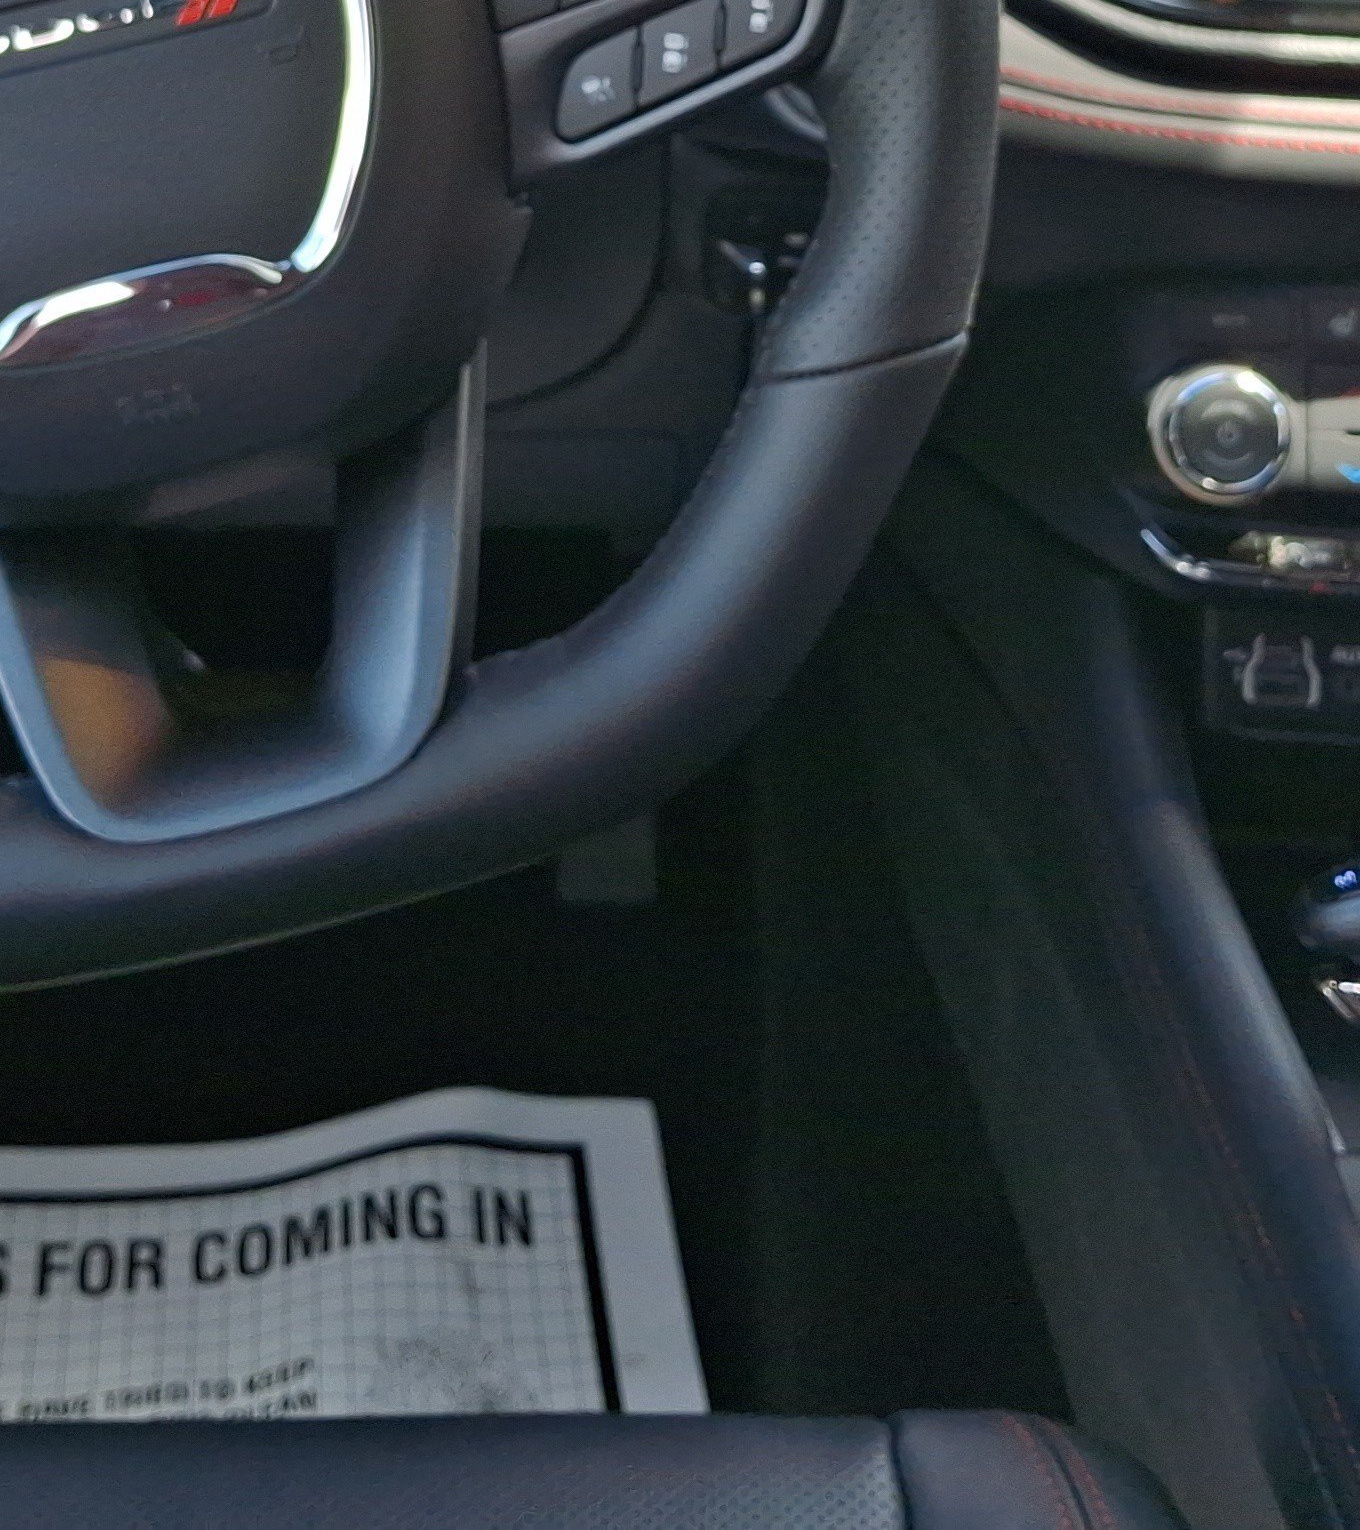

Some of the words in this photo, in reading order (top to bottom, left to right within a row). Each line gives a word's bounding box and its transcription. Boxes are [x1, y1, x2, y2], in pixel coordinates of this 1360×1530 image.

[32, 1236, 166, 1299] FOR
[191, 1181, 448, 1288] COMING
[469, 1185, 533, 1248] IN
